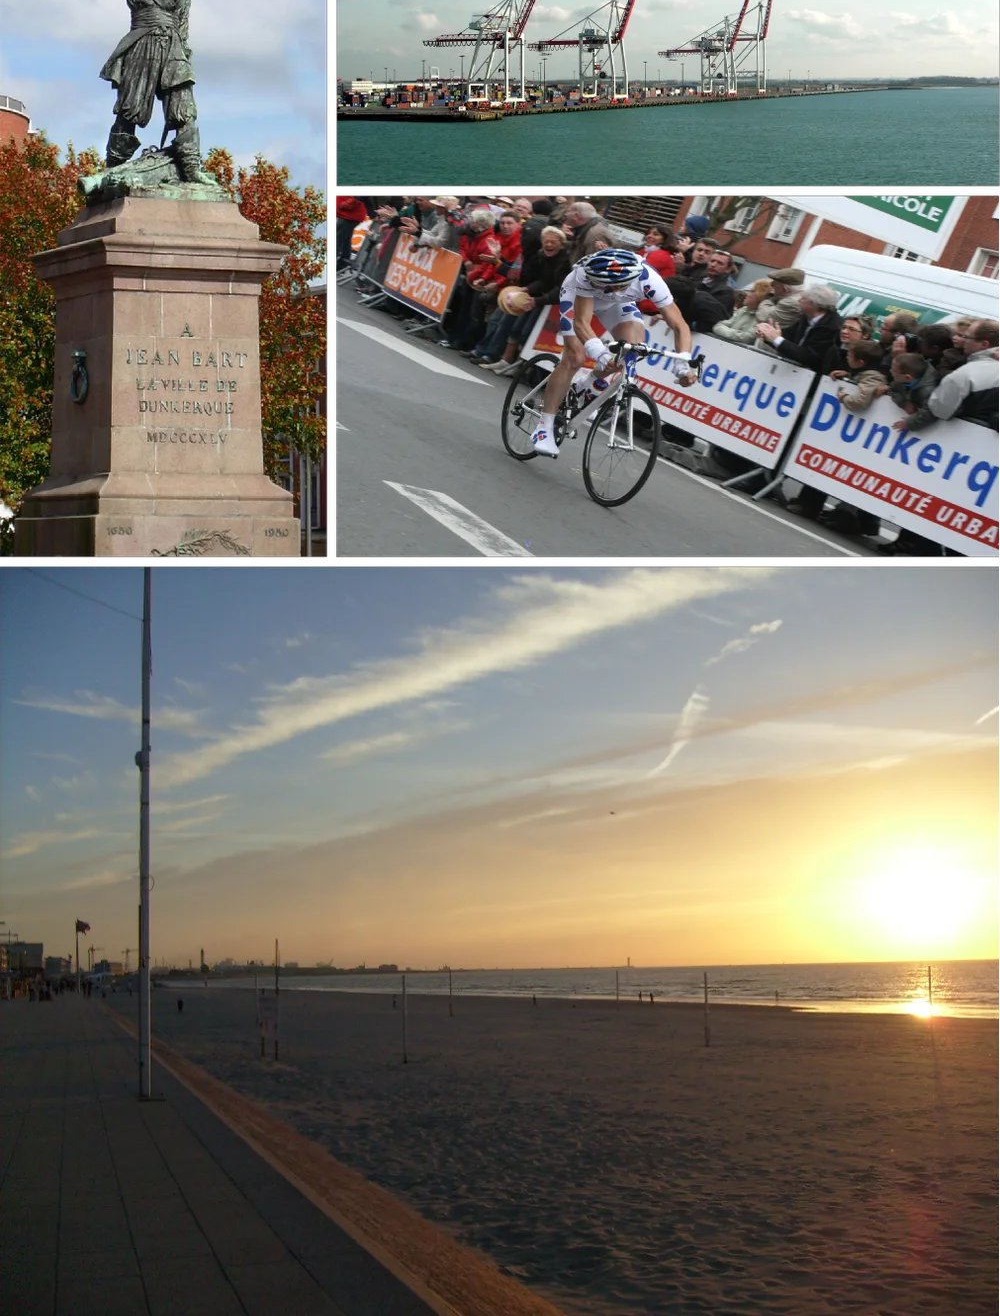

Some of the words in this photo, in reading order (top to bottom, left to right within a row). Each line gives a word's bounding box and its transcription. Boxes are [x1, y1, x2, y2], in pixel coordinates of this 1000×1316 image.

[386, 262, 407, 288] DES
[400, 270, 447, 307] SPORTS
[180, 322, 193, 337] A
[126, 349, 180, 366] JEAN
[192, 351, 248, 368] BART
[136, 378, 157, 391] LA
[160, 379, 208, 391] VILLE
[216, 380, 238, 392] DE
[138, 400, 234, 416] DUNKERQUE
[146, 432, 228, 444] MDCCCXLV
[711, 412, 780, 450] URBAINE
[798, 448, 934, 514] COMMUNAUTÉ
